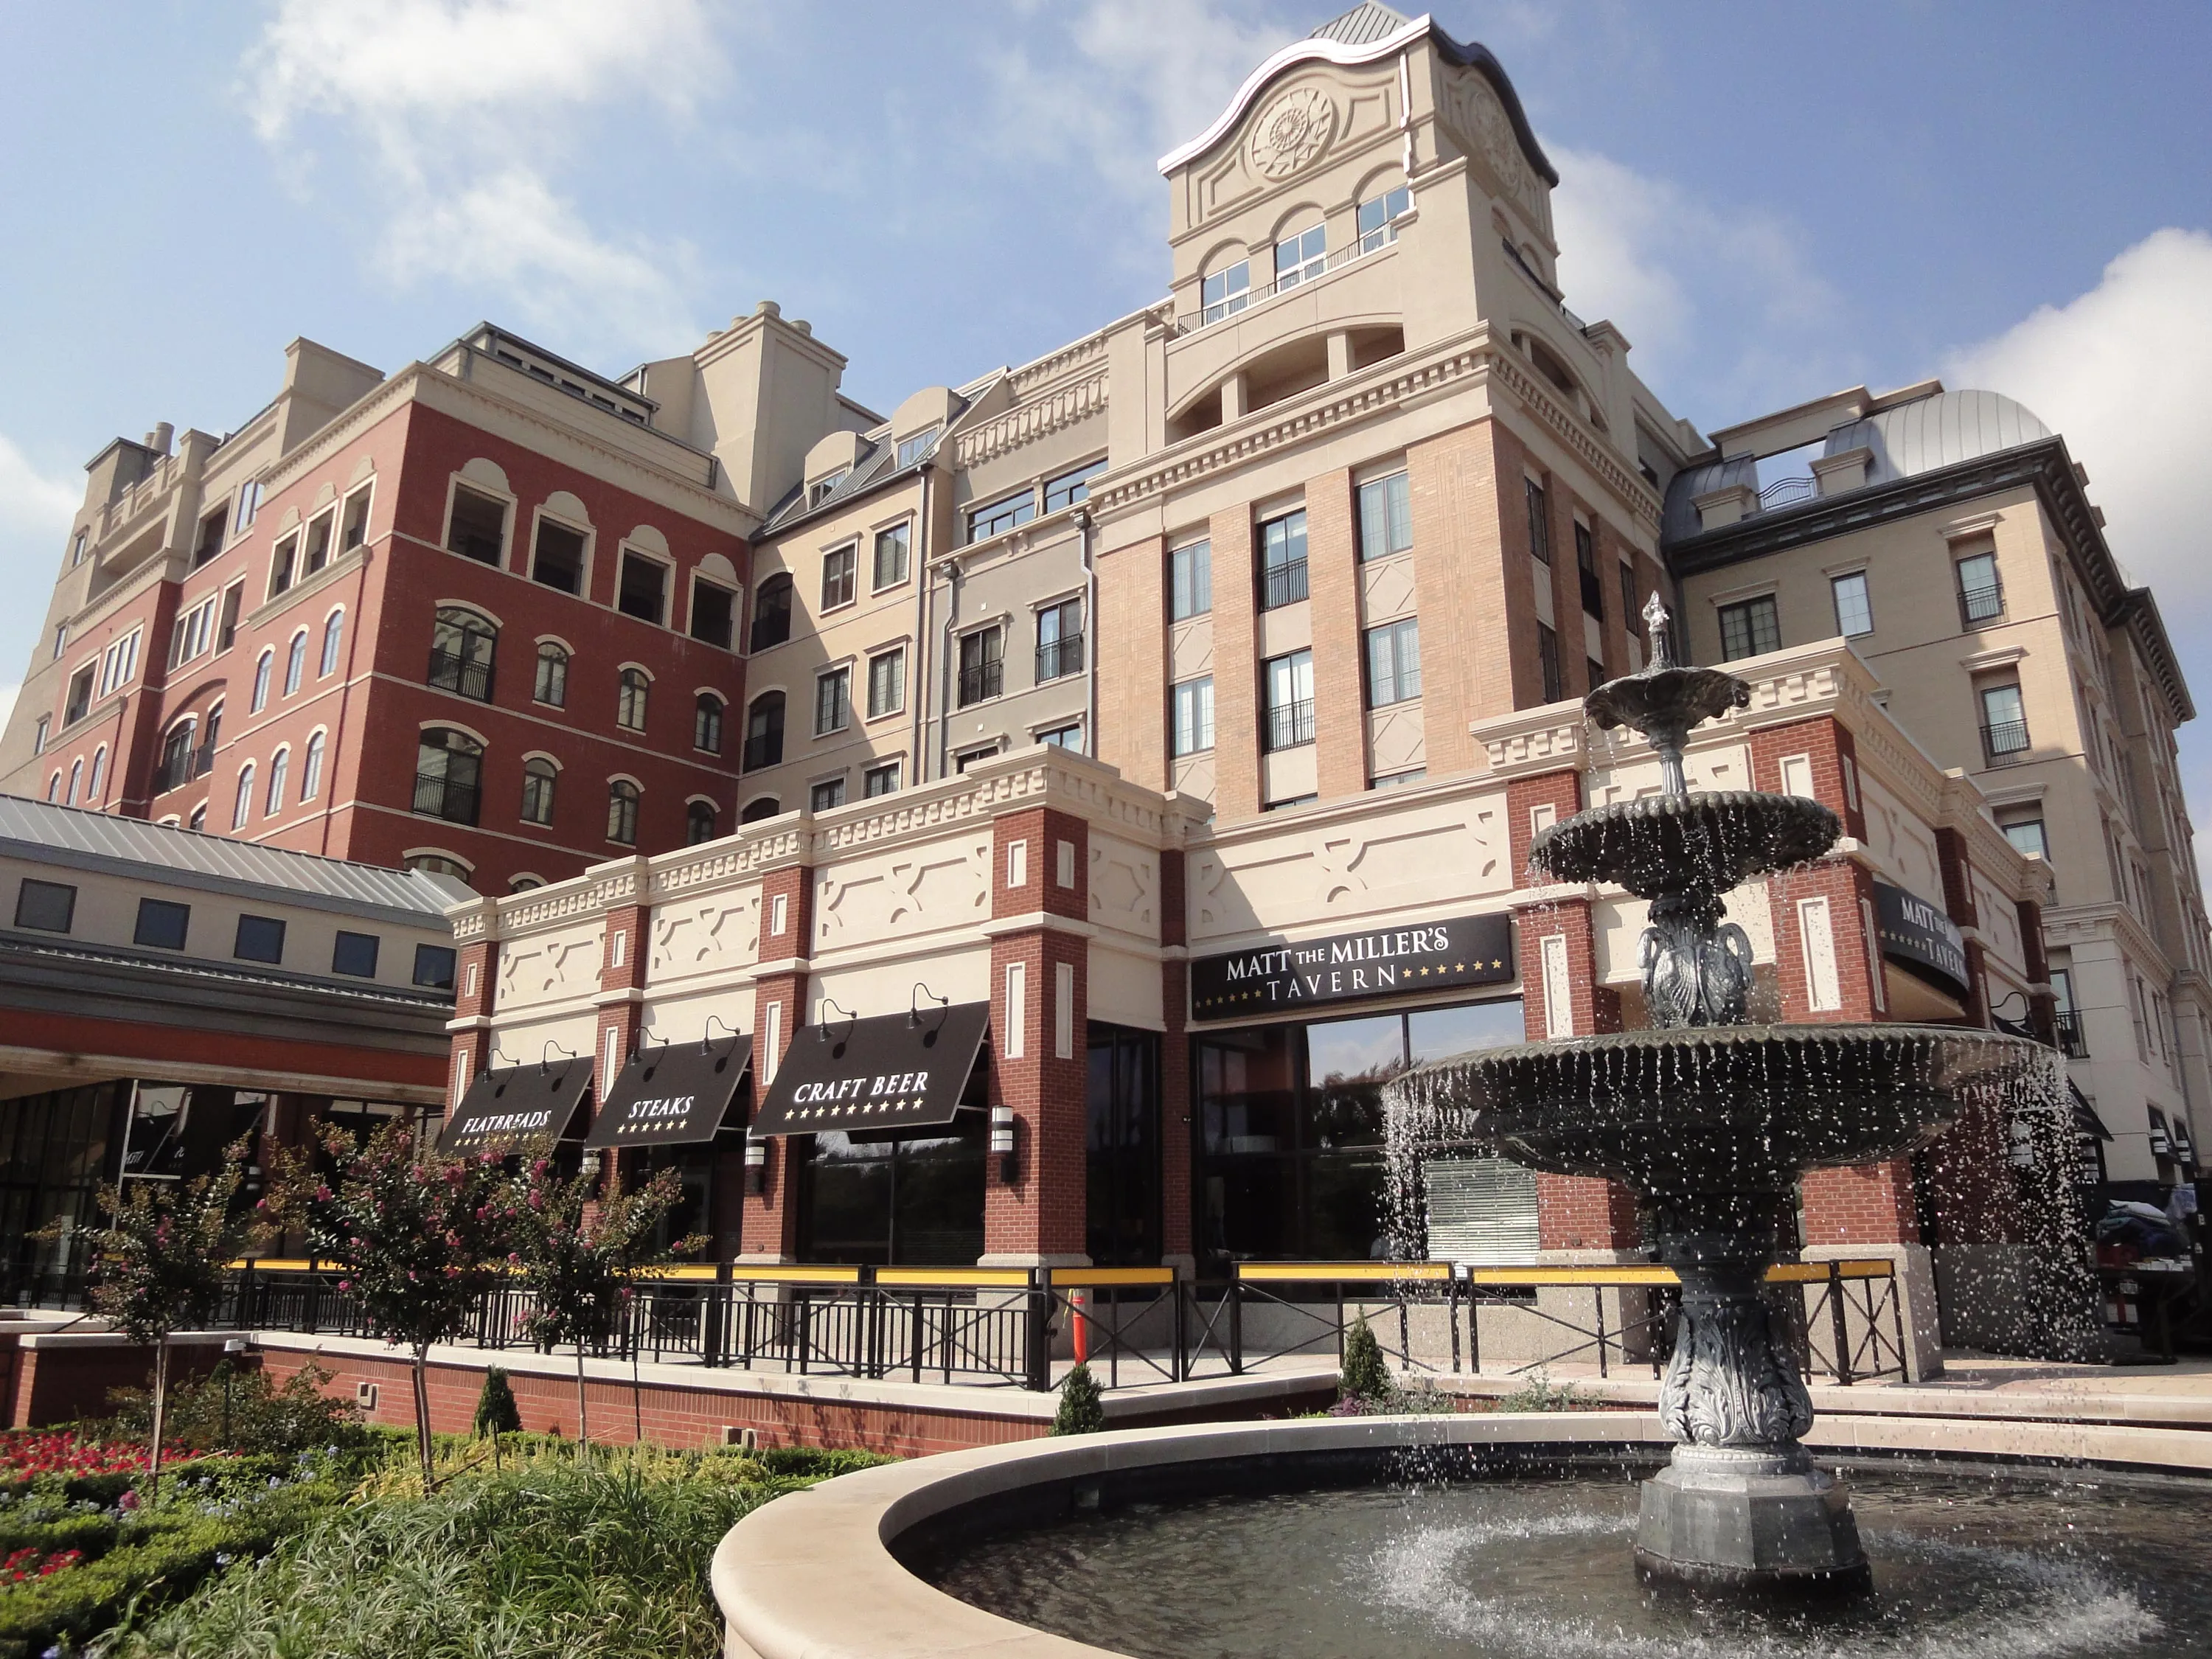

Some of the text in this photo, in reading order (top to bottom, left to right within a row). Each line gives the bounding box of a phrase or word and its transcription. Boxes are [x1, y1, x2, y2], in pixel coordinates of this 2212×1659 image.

[1901, 897, 1933, 932] MATT
[1226, 927, 1450, 981] MATT THE MILLER'S
[1267, 964, 1395, 1001] TAVERN
[794, 1071, 928, 1102] CRAFT BEER
[462, 1110, 552, 1133] FLATBREADS
[628, 1096, 695, 1118] STEAKS
